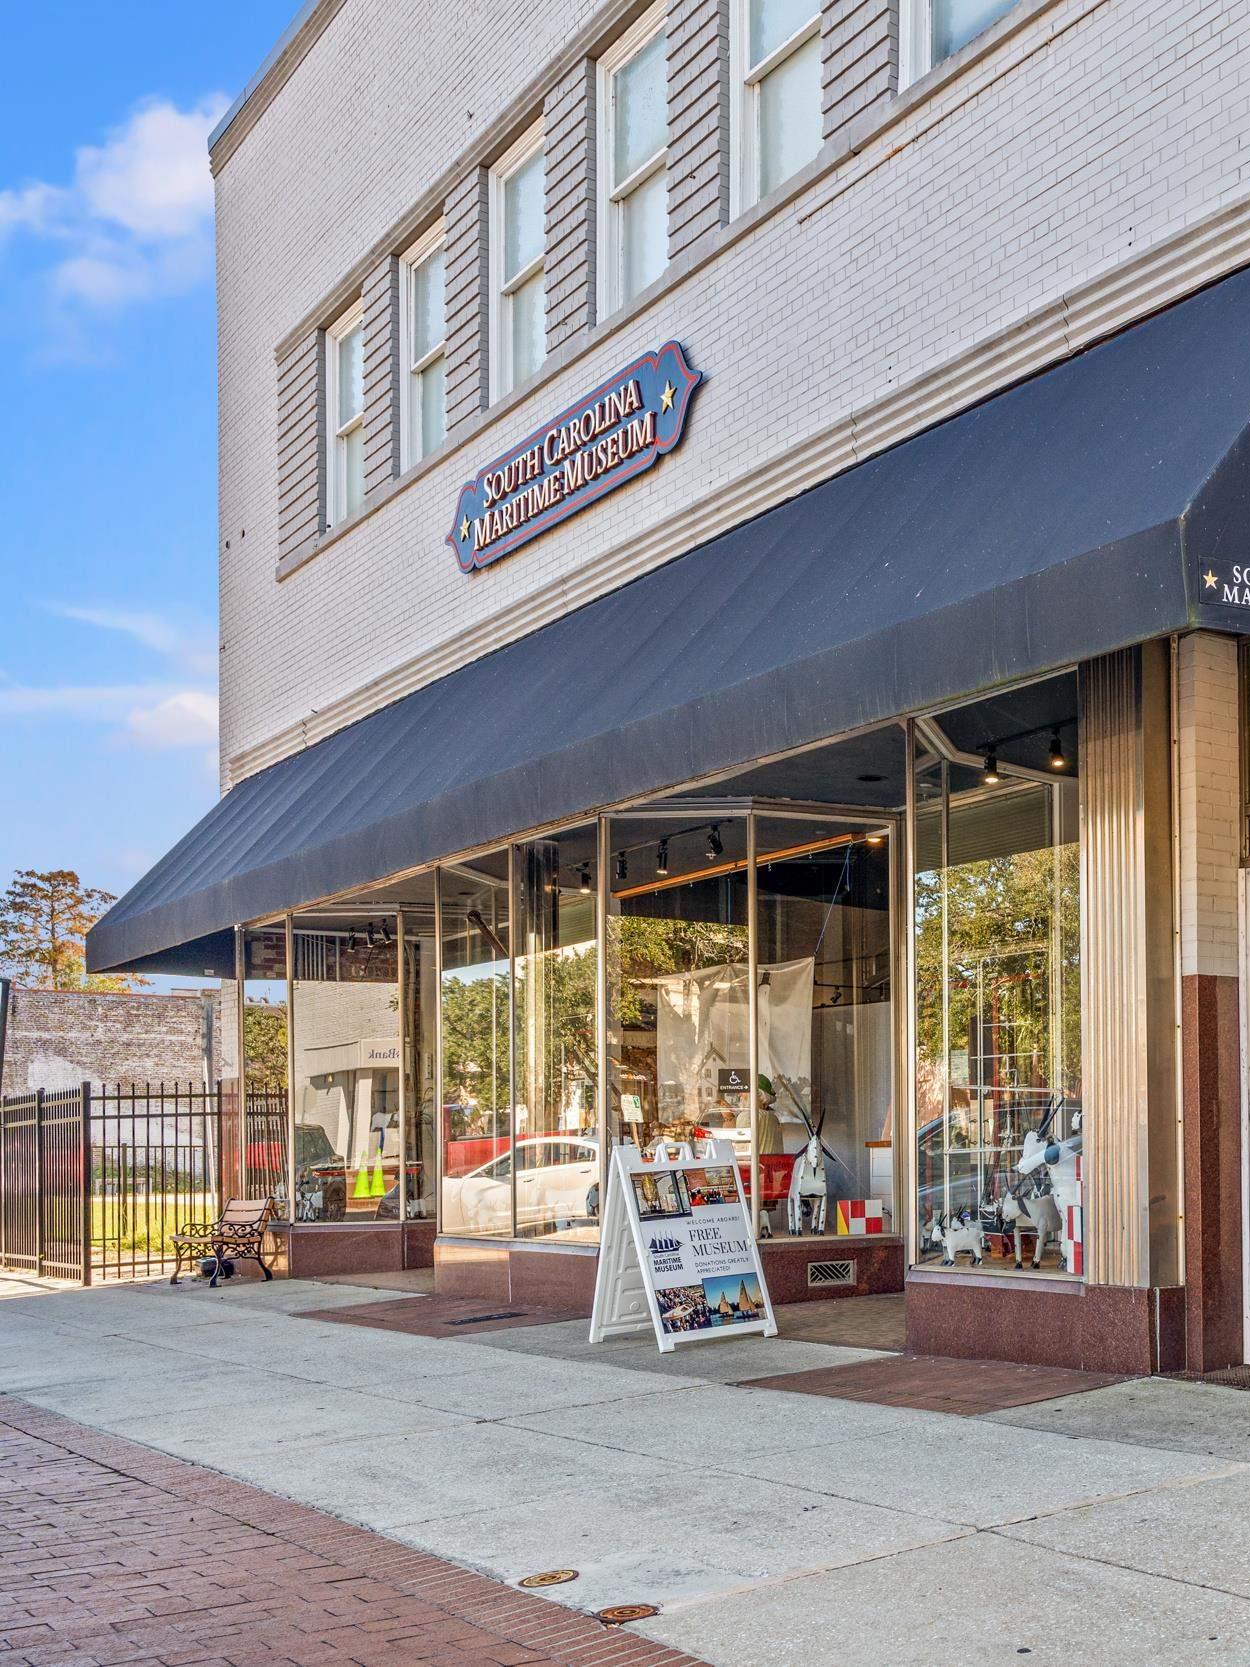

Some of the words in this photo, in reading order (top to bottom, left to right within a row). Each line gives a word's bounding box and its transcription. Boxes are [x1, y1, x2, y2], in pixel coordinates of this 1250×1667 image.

[484, 445, 543, 508] SOUTH
[544, 379, 642, 466] CAROLINA
[473, 470, 563, 551] MARITIME
[563, 411, 657, 495] MUSEUM
[688, 1227, 722, 1241] FREE
[692, 1240, 748, 1257] MUSEUM
[653, 1256, 682, 1266] MARITIME
[654, 1263, 684, 1273] MUSEUM
[695, 1259, 727, 1268] DONATIONS
